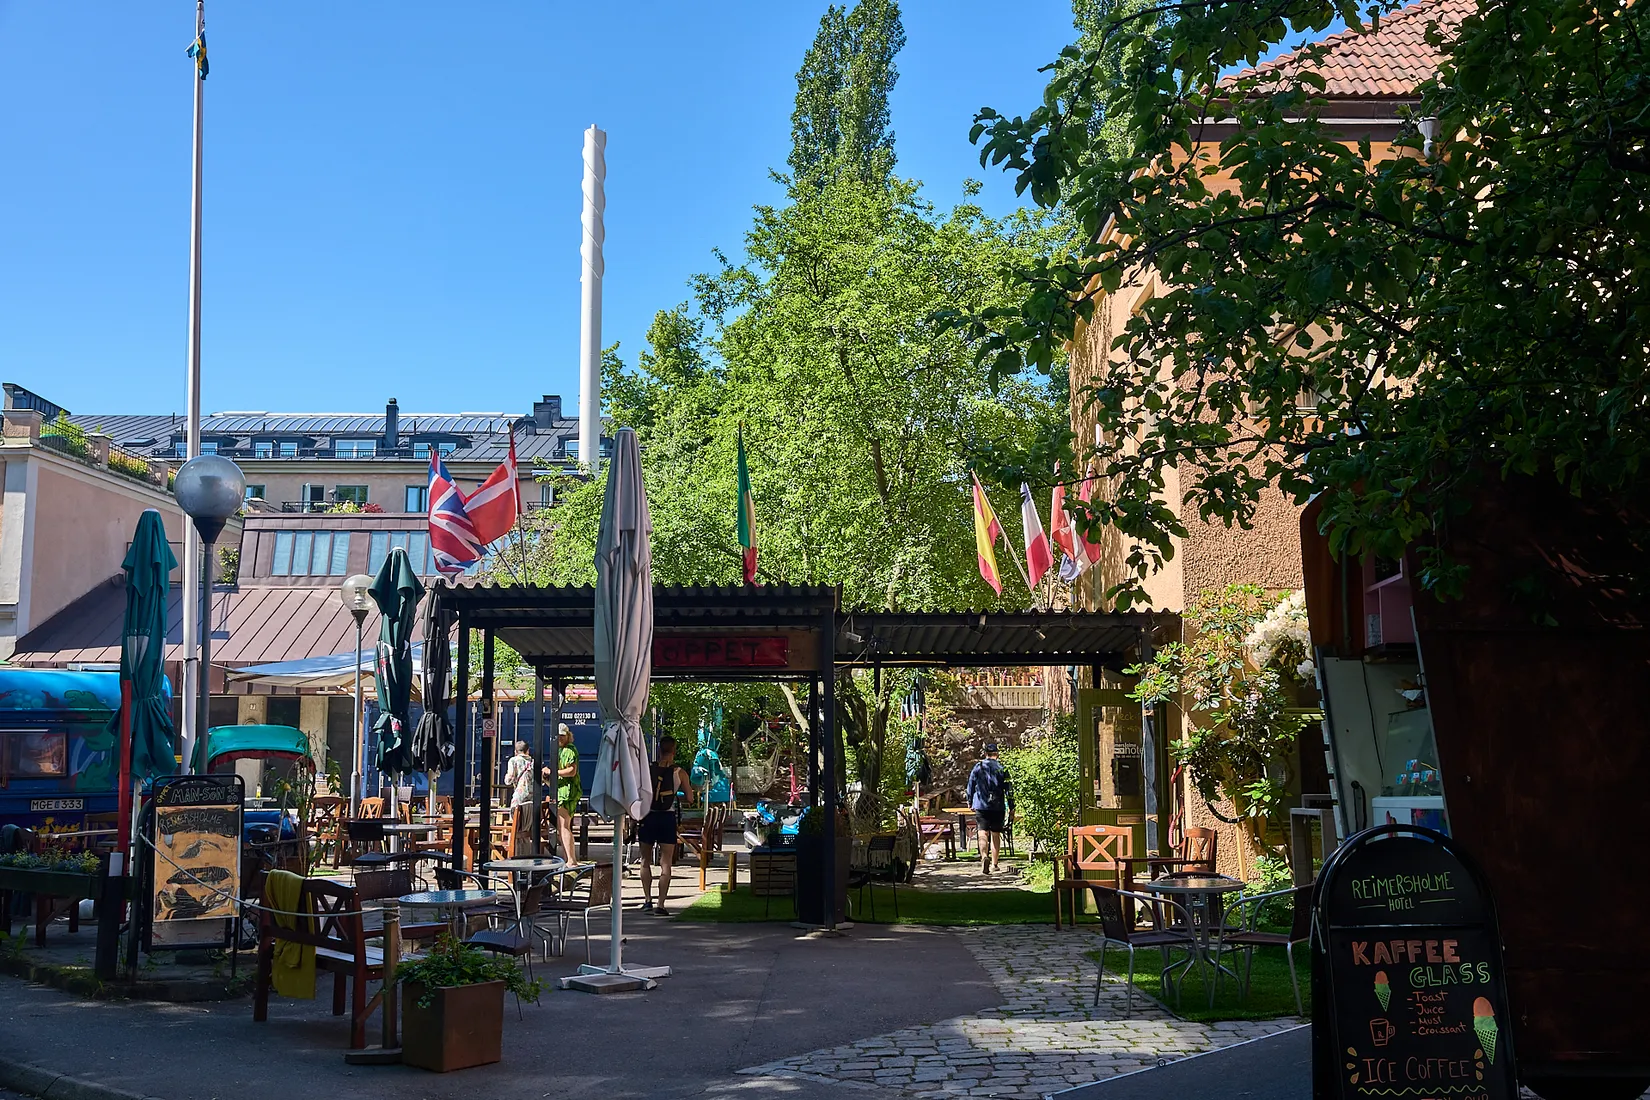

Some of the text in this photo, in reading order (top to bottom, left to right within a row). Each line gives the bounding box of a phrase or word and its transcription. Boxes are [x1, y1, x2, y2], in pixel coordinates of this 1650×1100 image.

[31, 799, 82, 810] MGE 333
[1388, 897, 1415, 912] HOTEL
[1351, 938, 1461, 966] KAFFEE
[1409, 961, 1491, 989] GLASS
[1362, 1057, 1397, 1084] ICE
